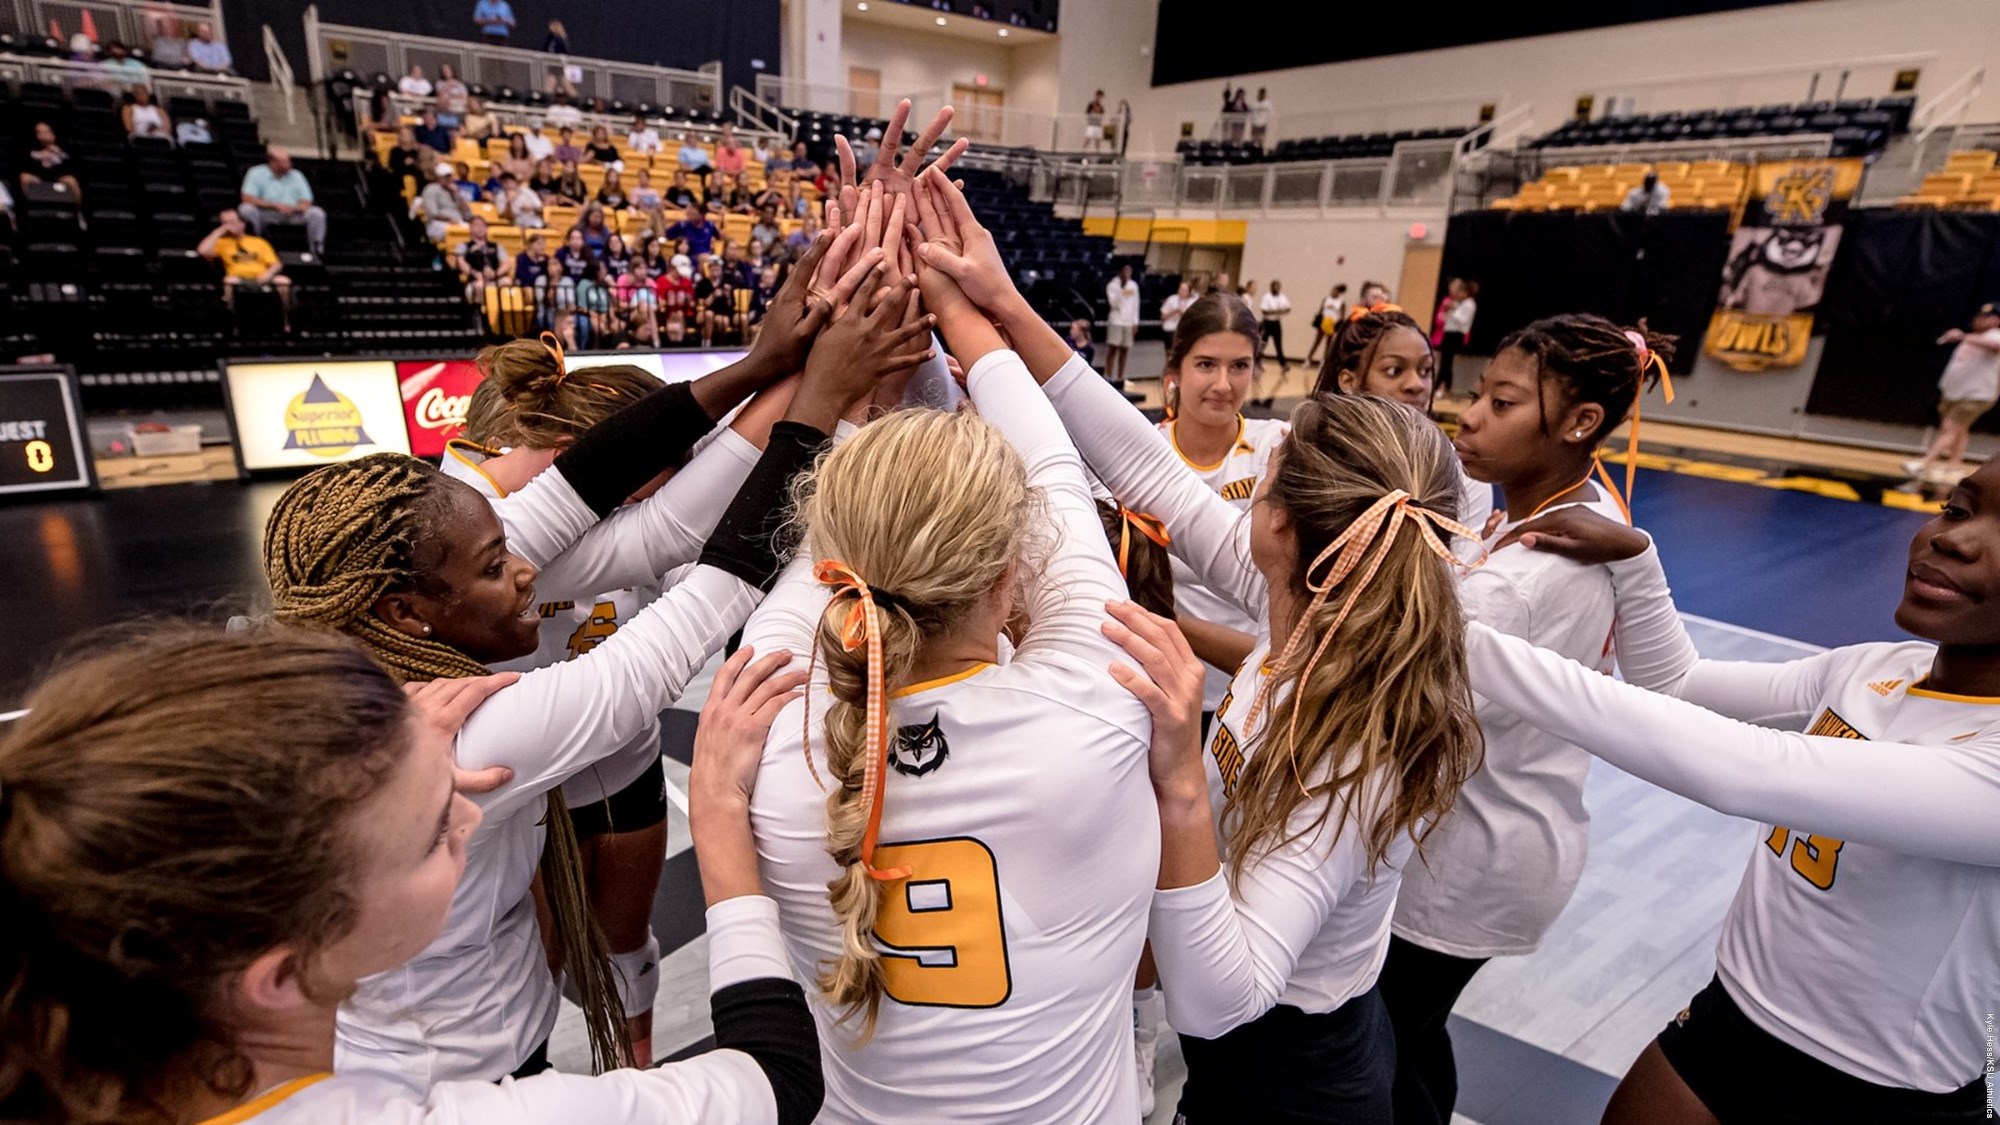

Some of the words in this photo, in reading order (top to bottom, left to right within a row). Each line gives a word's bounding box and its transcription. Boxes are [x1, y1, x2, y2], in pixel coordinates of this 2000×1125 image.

[25, 440, 54, 472] 0
[1211, 722, 1245, 799] STATE
[872, 836, 1012, 1009] 9
